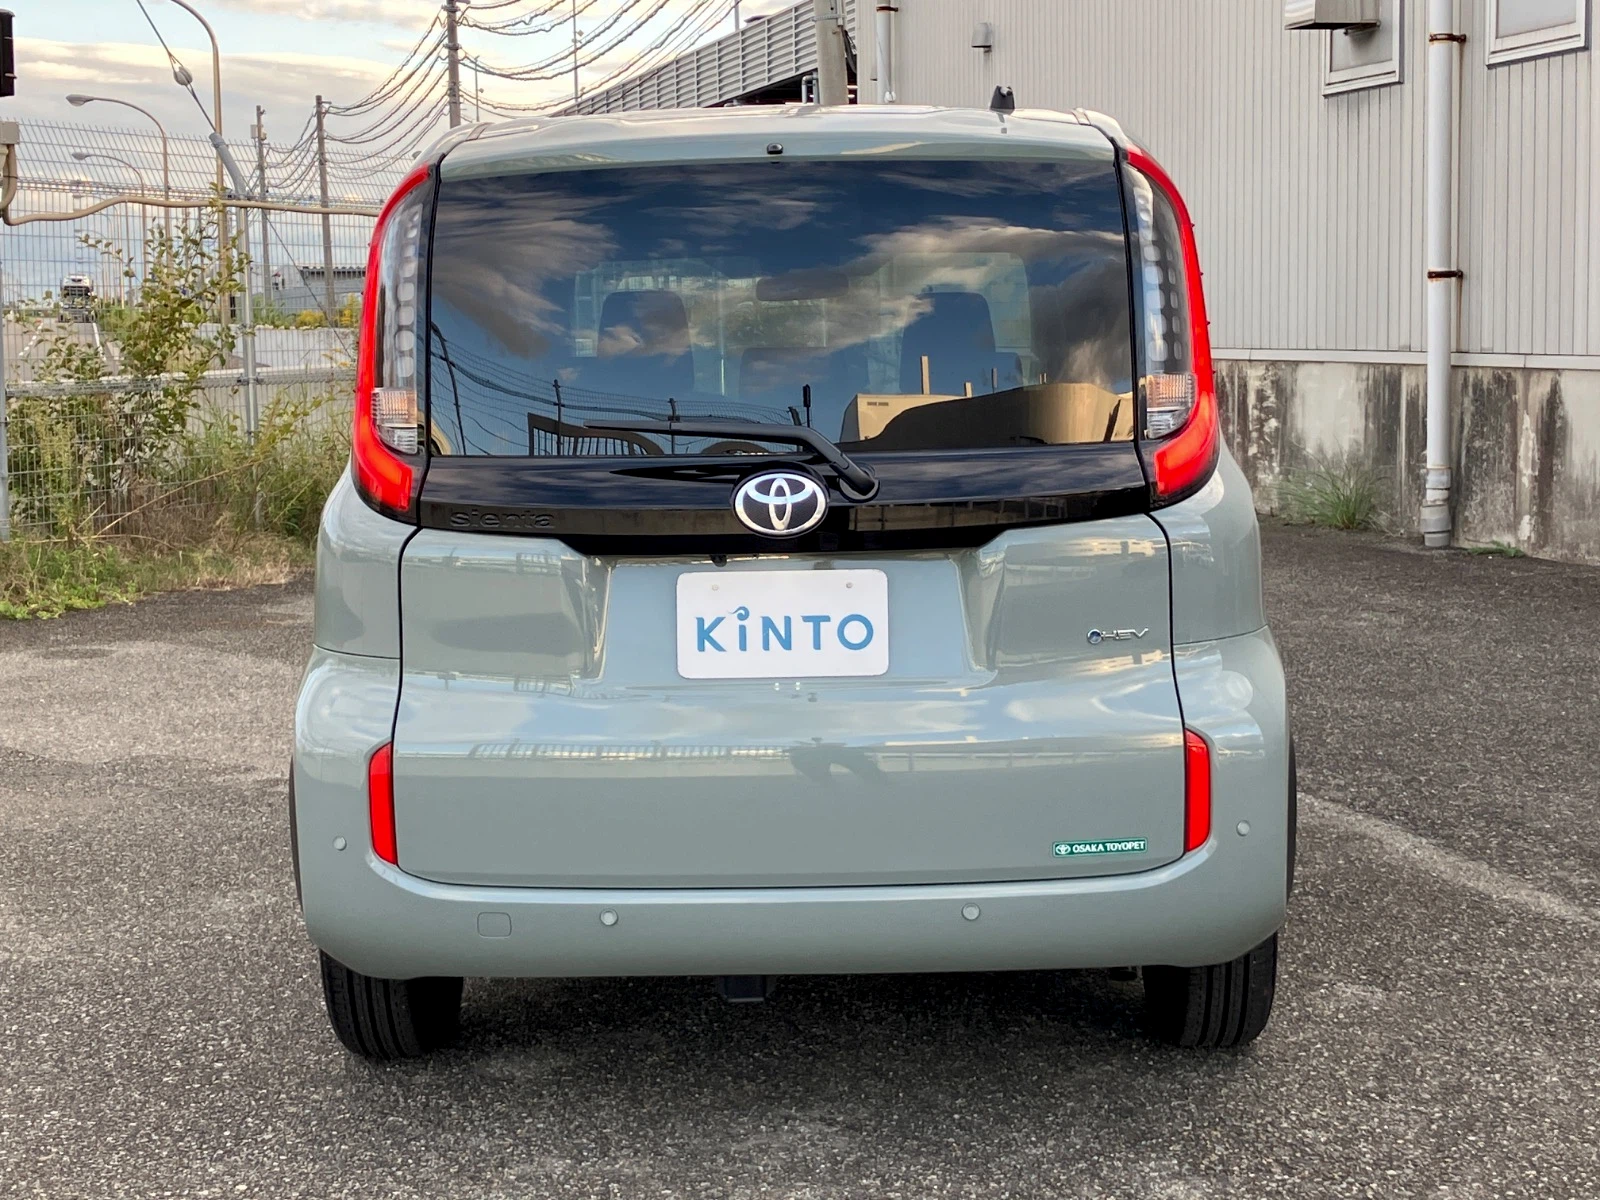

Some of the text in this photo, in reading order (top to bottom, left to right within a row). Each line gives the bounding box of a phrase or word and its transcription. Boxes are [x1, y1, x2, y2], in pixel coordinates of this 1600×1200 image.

[450, 508, 555, 528] sienta
[1072, 841, 1145, 853] OSAKA TOYOPET
